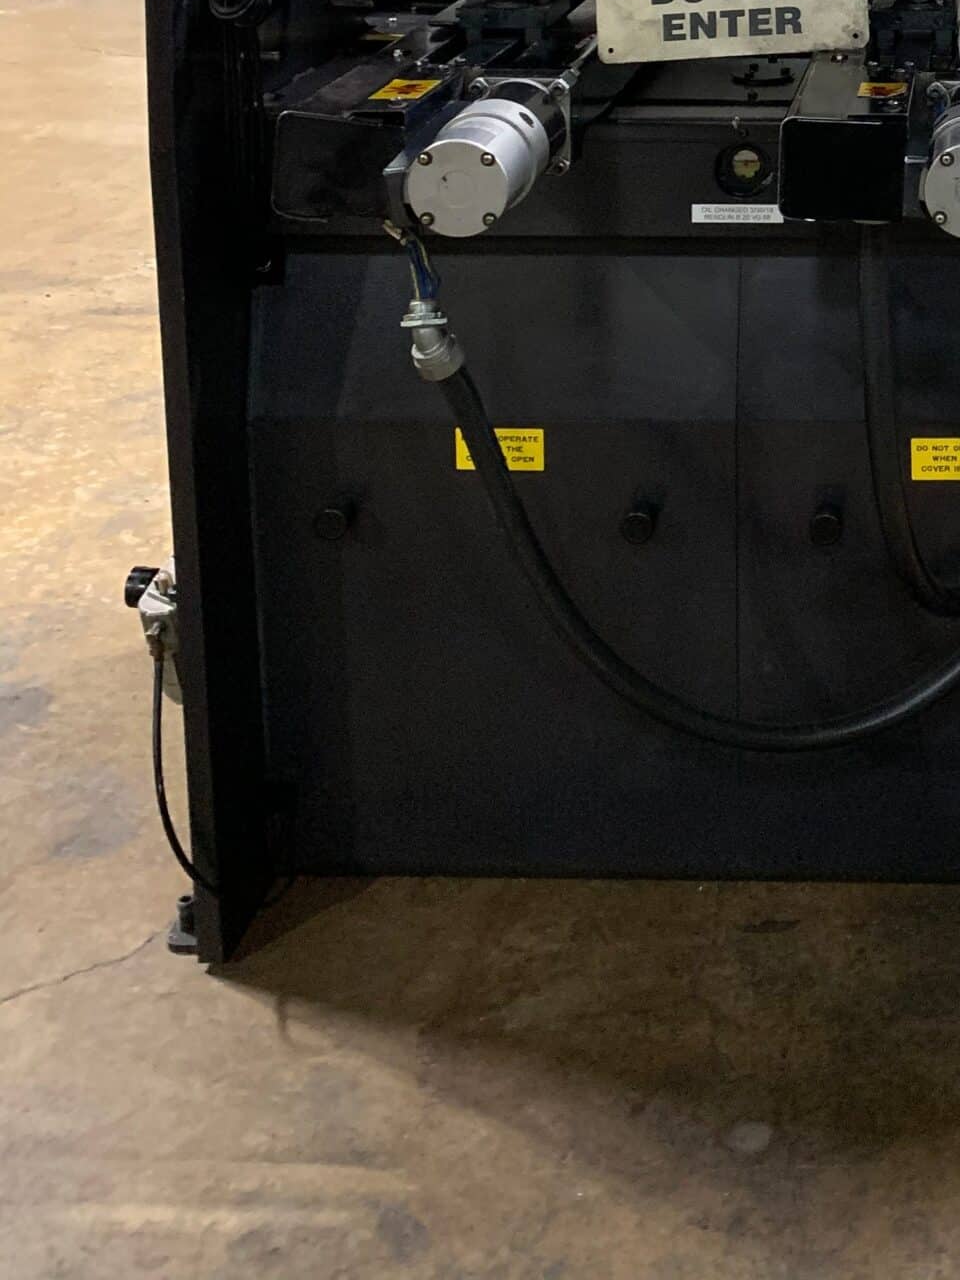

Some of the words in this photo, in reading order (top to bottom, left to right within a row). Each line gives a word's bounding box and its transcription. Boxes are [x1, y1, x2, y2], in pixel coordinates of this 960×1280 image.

[662, 6, 803, 42] ENTER
[498, 435, 540, 444] OPERATE
[511, 455, 535, 463] OPEN
